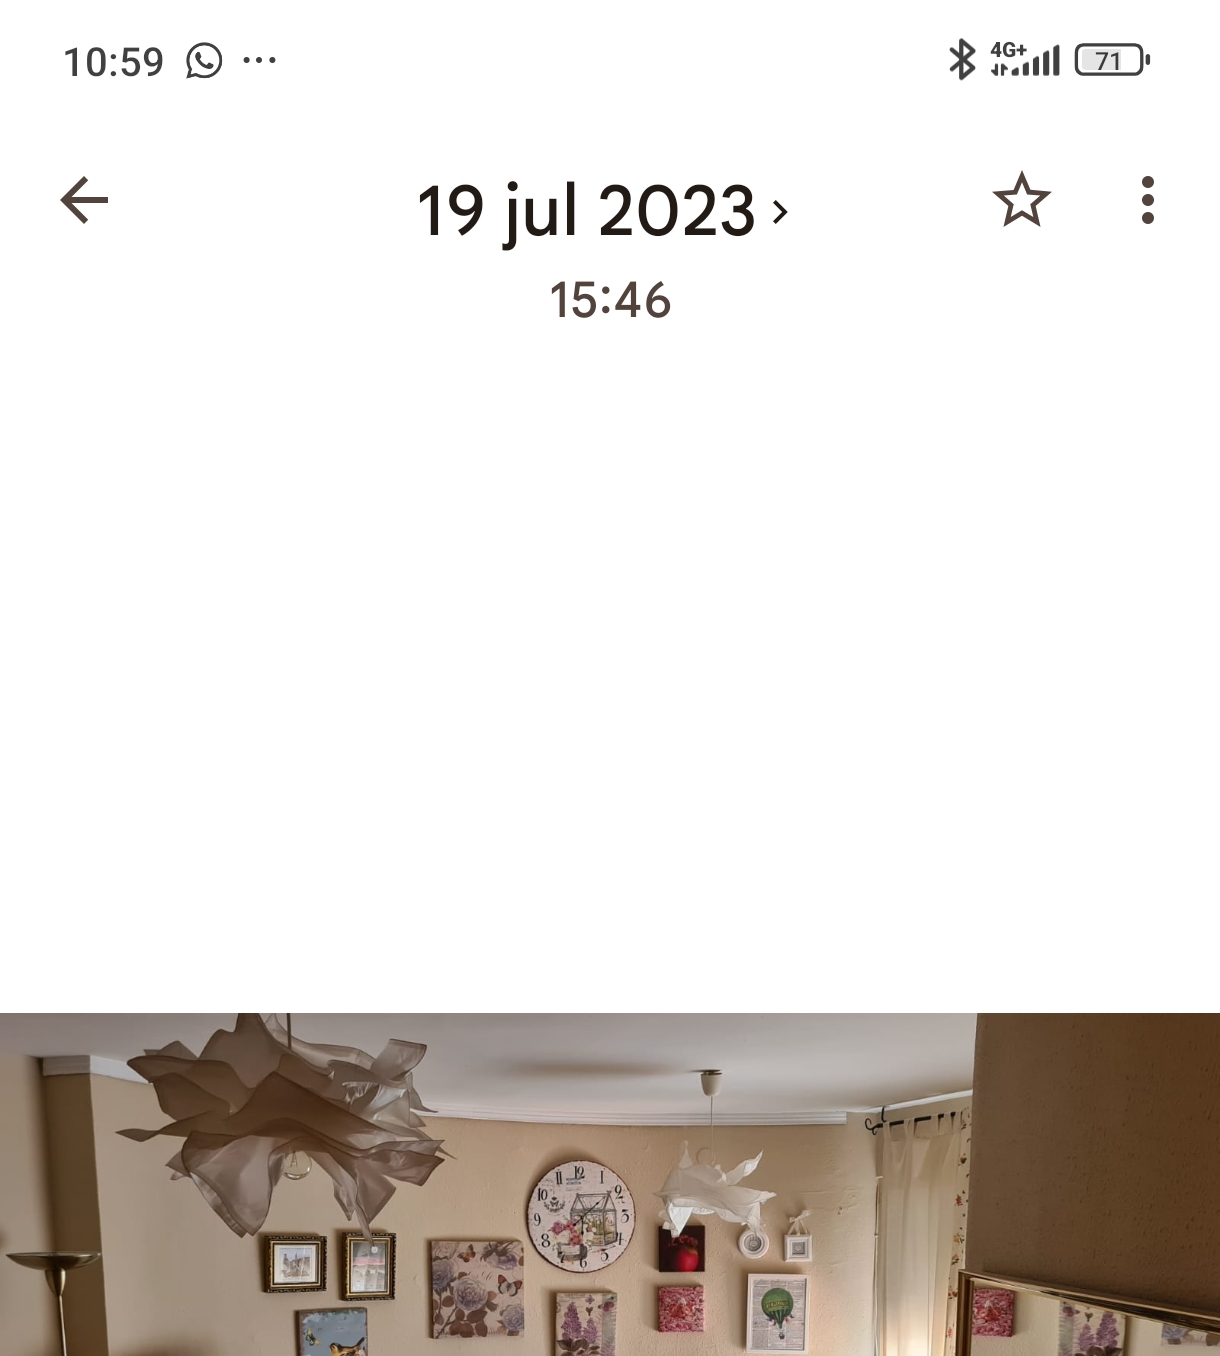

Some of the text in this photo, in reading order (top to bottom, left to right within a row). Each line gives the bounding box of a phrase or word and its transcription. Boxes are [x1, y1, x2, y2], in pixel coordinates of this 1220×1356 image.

[990, 41, 1028, 58] 4G+
[65, 46, 163, 77] 10:59
[1095, 52, 1119, 70] 71
[420, 181, 755, 252] 19 jul 2023
[552, 280, 671, 319] 15:46
[574, 1165, 585, 1179] 12
[537, 1187, 548, 1201] 10
[614, 1185, 624, 1200] 2
[533, 1213, 541, 1227] 9
[541, 1233, 551, 1248] 8
[579, 1257, 588, 1268] 6
[600, 1248, 609, 1262] 5
